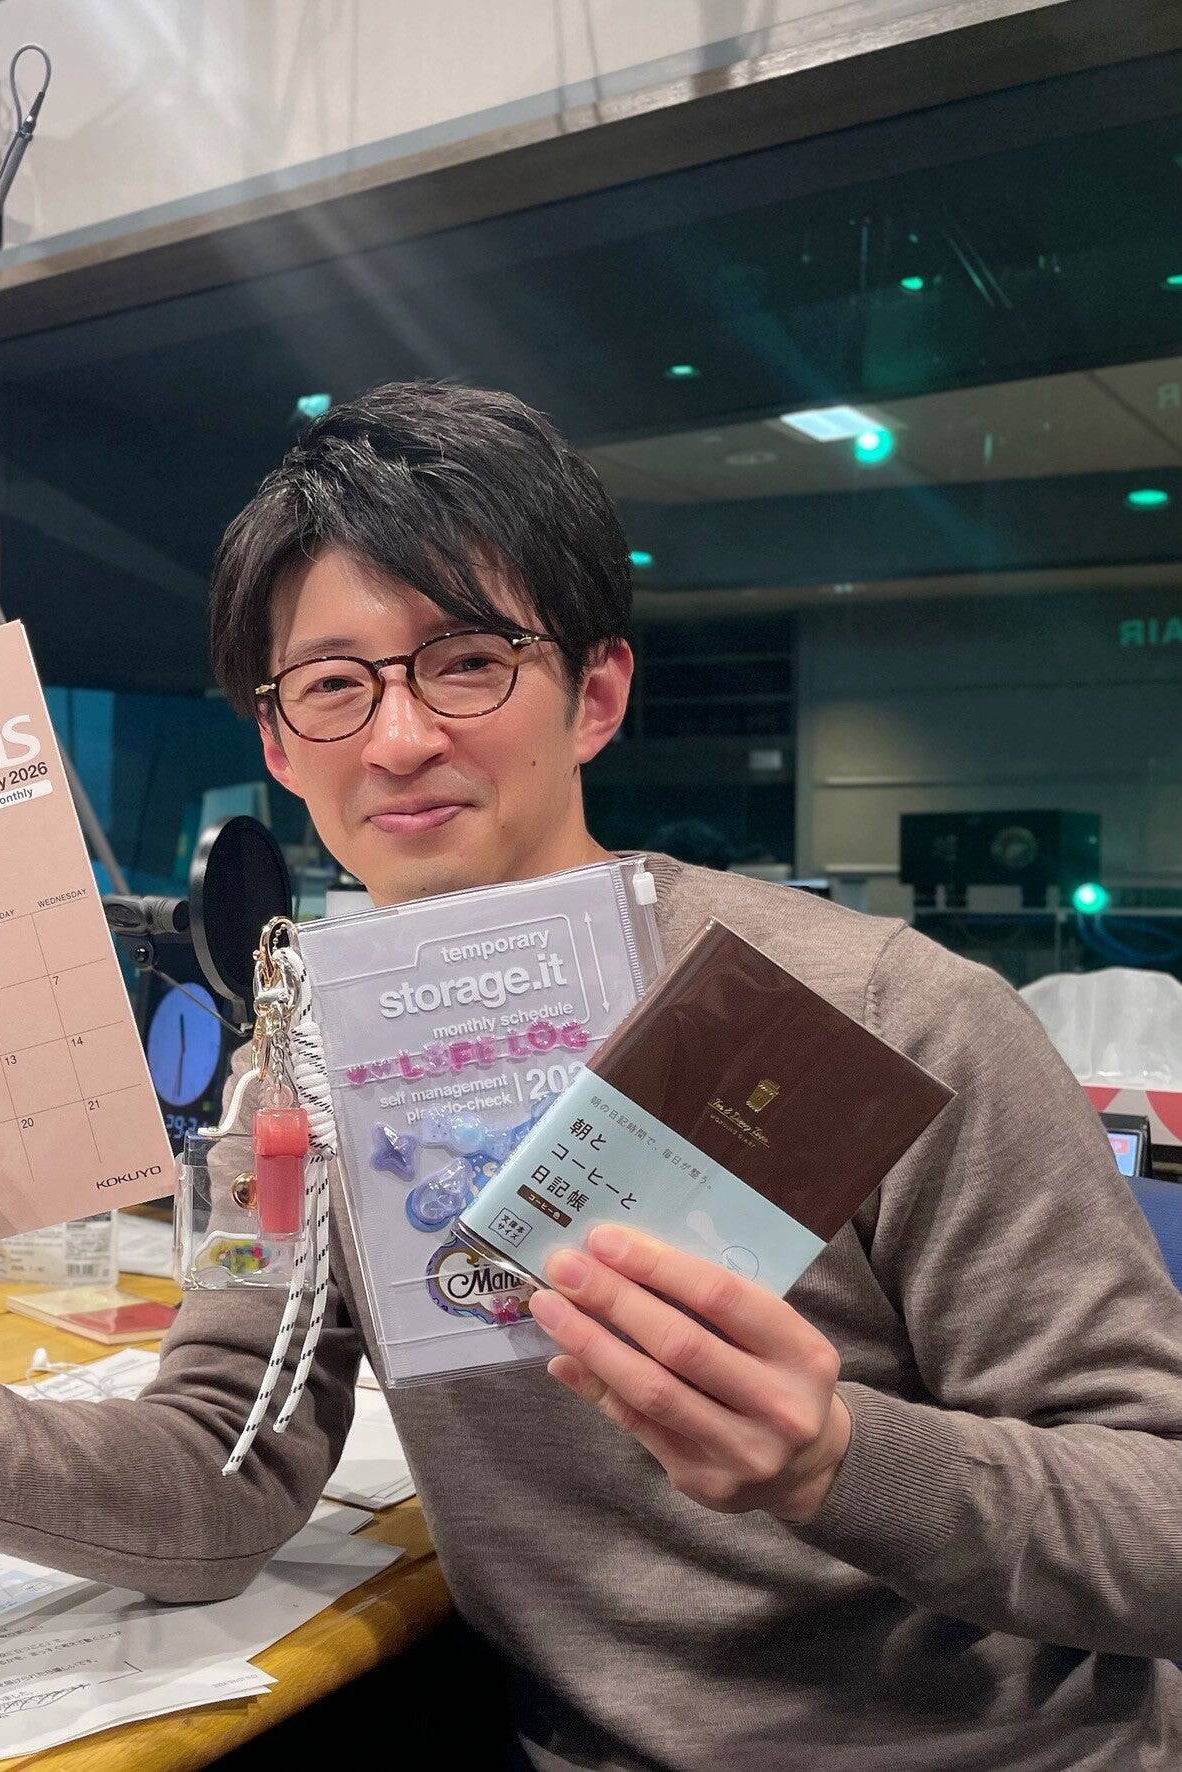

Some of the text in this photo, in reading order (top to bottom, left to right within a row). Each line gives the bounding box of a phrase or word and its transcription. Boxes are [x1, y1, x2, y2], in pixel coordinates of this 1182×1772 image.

[8, 761, 48, 786] 2026
[37, 889, 88, 909] WEDNESDAY
[441, 929, 550, 964] temporary
[52, 975, 60, 986] 7
[379, 953, 568, 1019] storage.it
[432, 1001, 575, 1040] monthly schedule
[5, 1054, 17, 1066] 13
[71, 1036, 84, 1047] 14
[507, 1019, 590, 1059] LOG
[379, 1074, 509, 1109] self management
[21, 1098, 101, 1129] 20 21
[569, 1118, 608, 1151] 朝と
[96, 1165, 162, 1190] KOKUYO
[530, 1166, 590, 1213] 日記帳
[551, 1142, 638, 1210] コーヒーと
